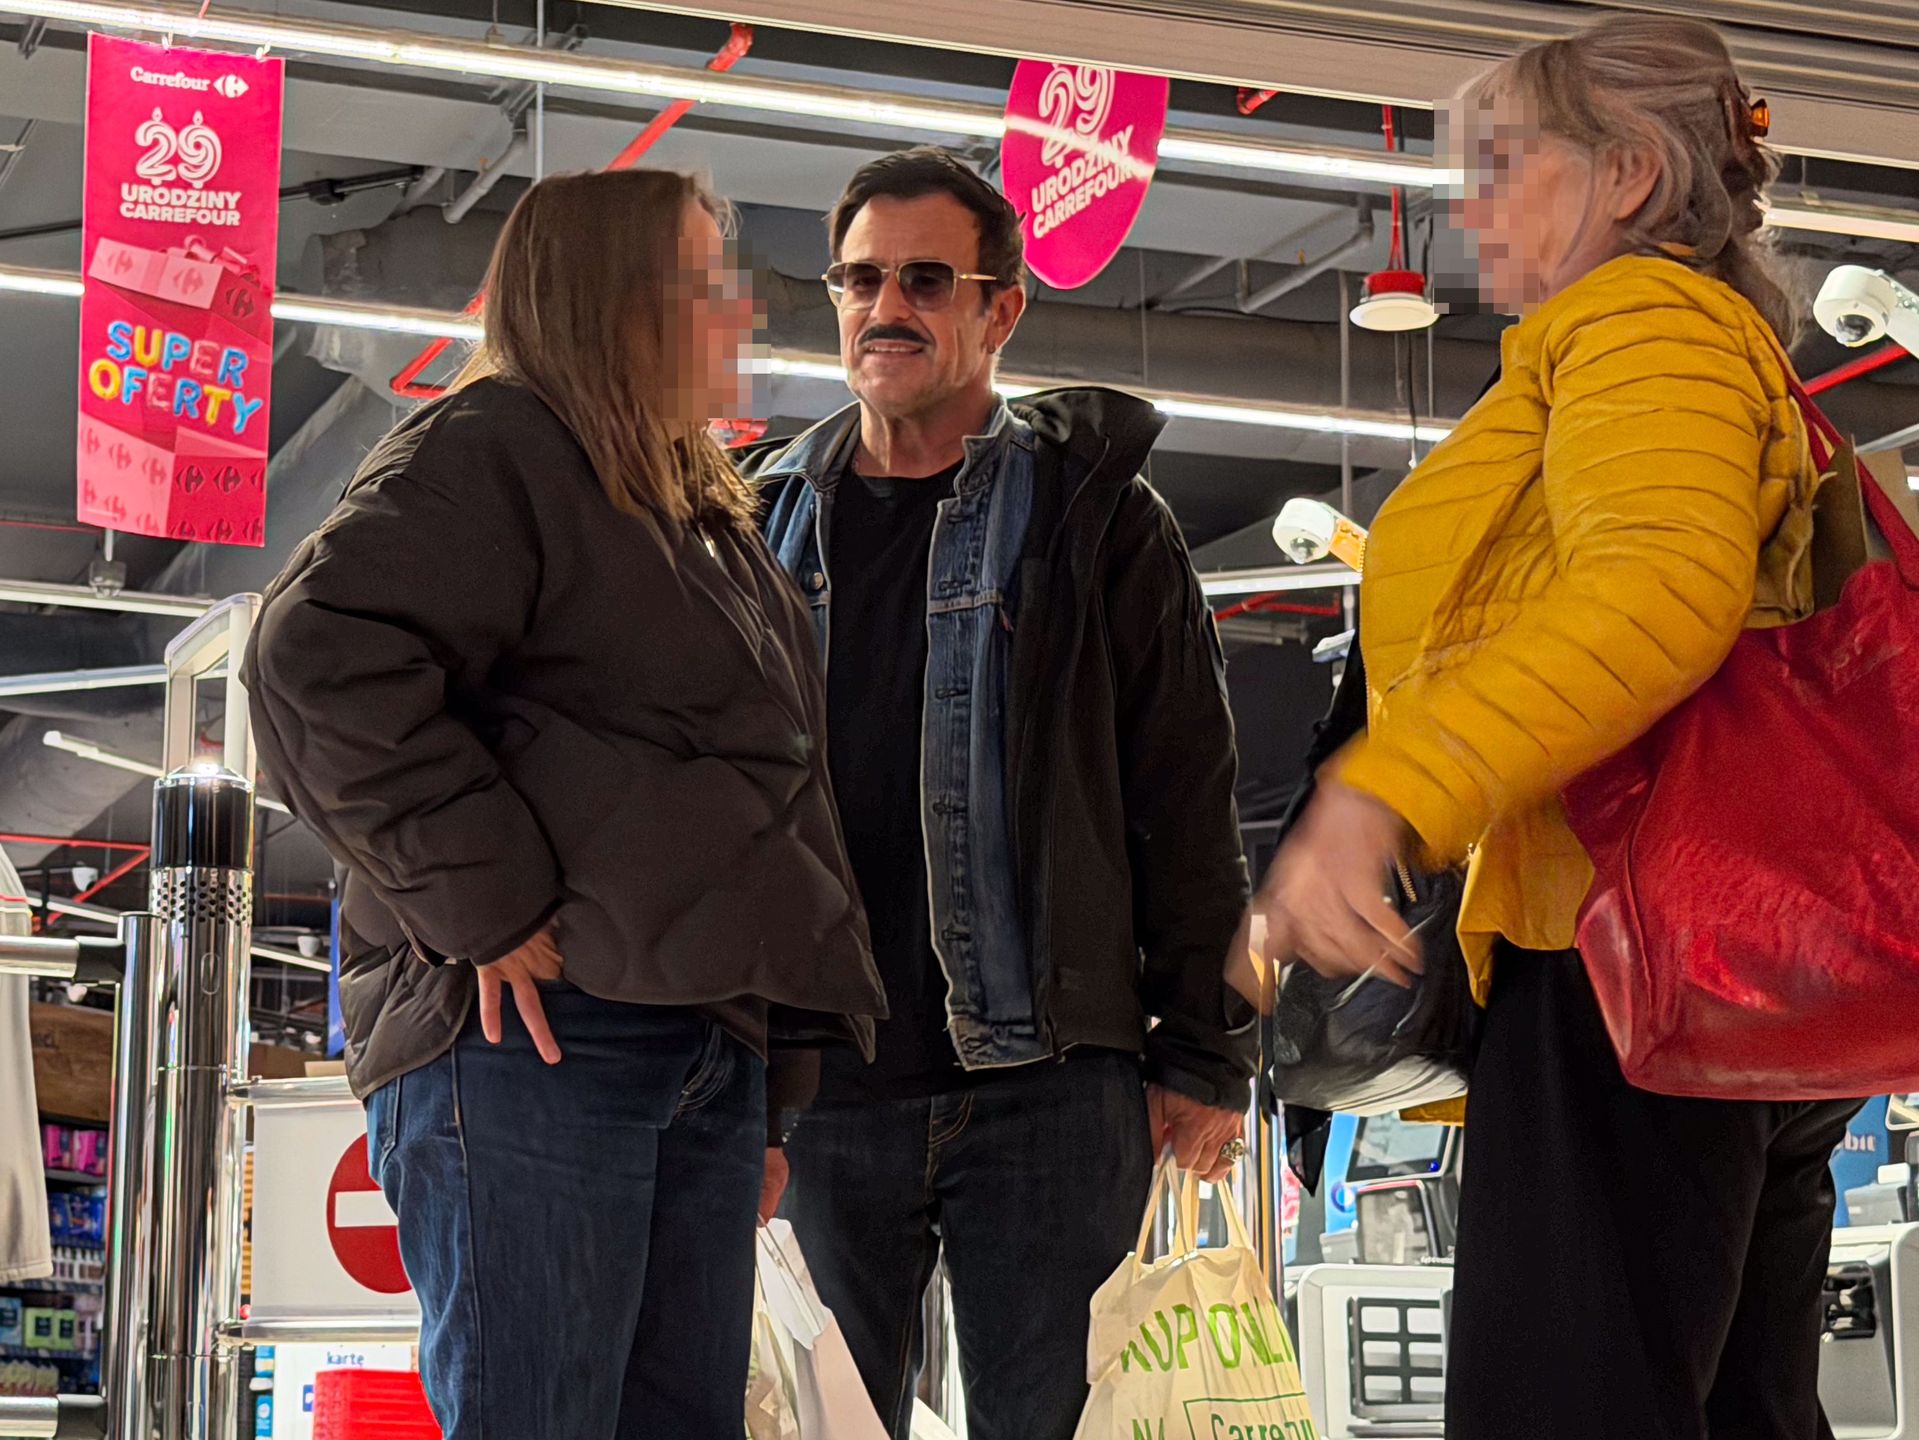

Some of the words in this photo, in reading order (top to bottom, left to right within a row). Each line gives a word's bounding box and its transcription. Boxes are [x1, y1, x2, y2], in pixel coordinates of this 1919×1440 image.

[130, 66, 211, 92] Carrefour
[135, 116, 222, 188] 29
[1038, 65, 1115, 168] 29
[121, 183, 242, 209] URODZINY
[1031, 124, 1134, 214] URODZINY
[1032, 161, 1136, 239] CARREFOUR
[120, 203, 241, 226] CARREFOUR
[107, 320, 248, 388] SUPER
[89, 358, 263, 434] OFERTY
